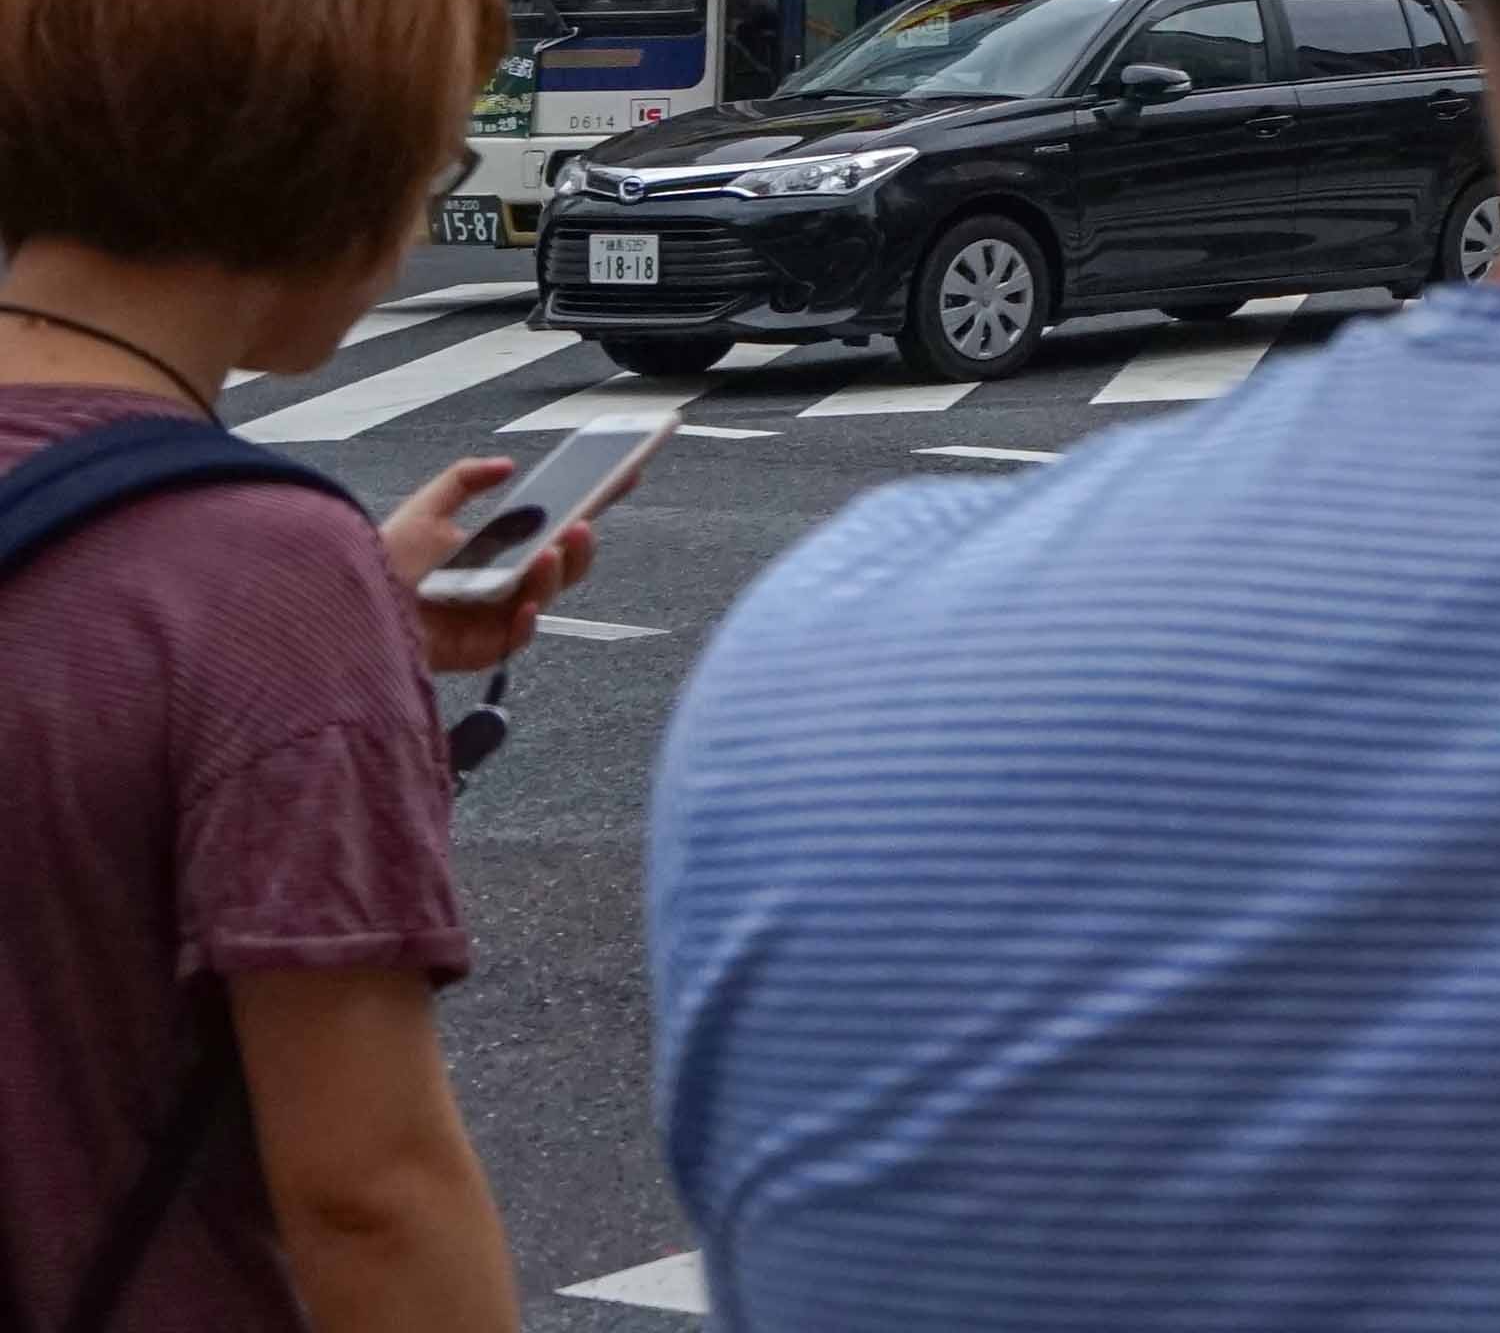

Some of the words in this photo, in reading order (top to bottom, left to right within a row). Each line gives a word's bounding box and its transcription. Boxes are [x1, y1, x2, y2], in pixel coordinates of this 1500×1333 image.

[569, 116, 616, 129] D614
[442, 211, 499, 242] 15-87
[607, 255, 655, 281] 18-18
